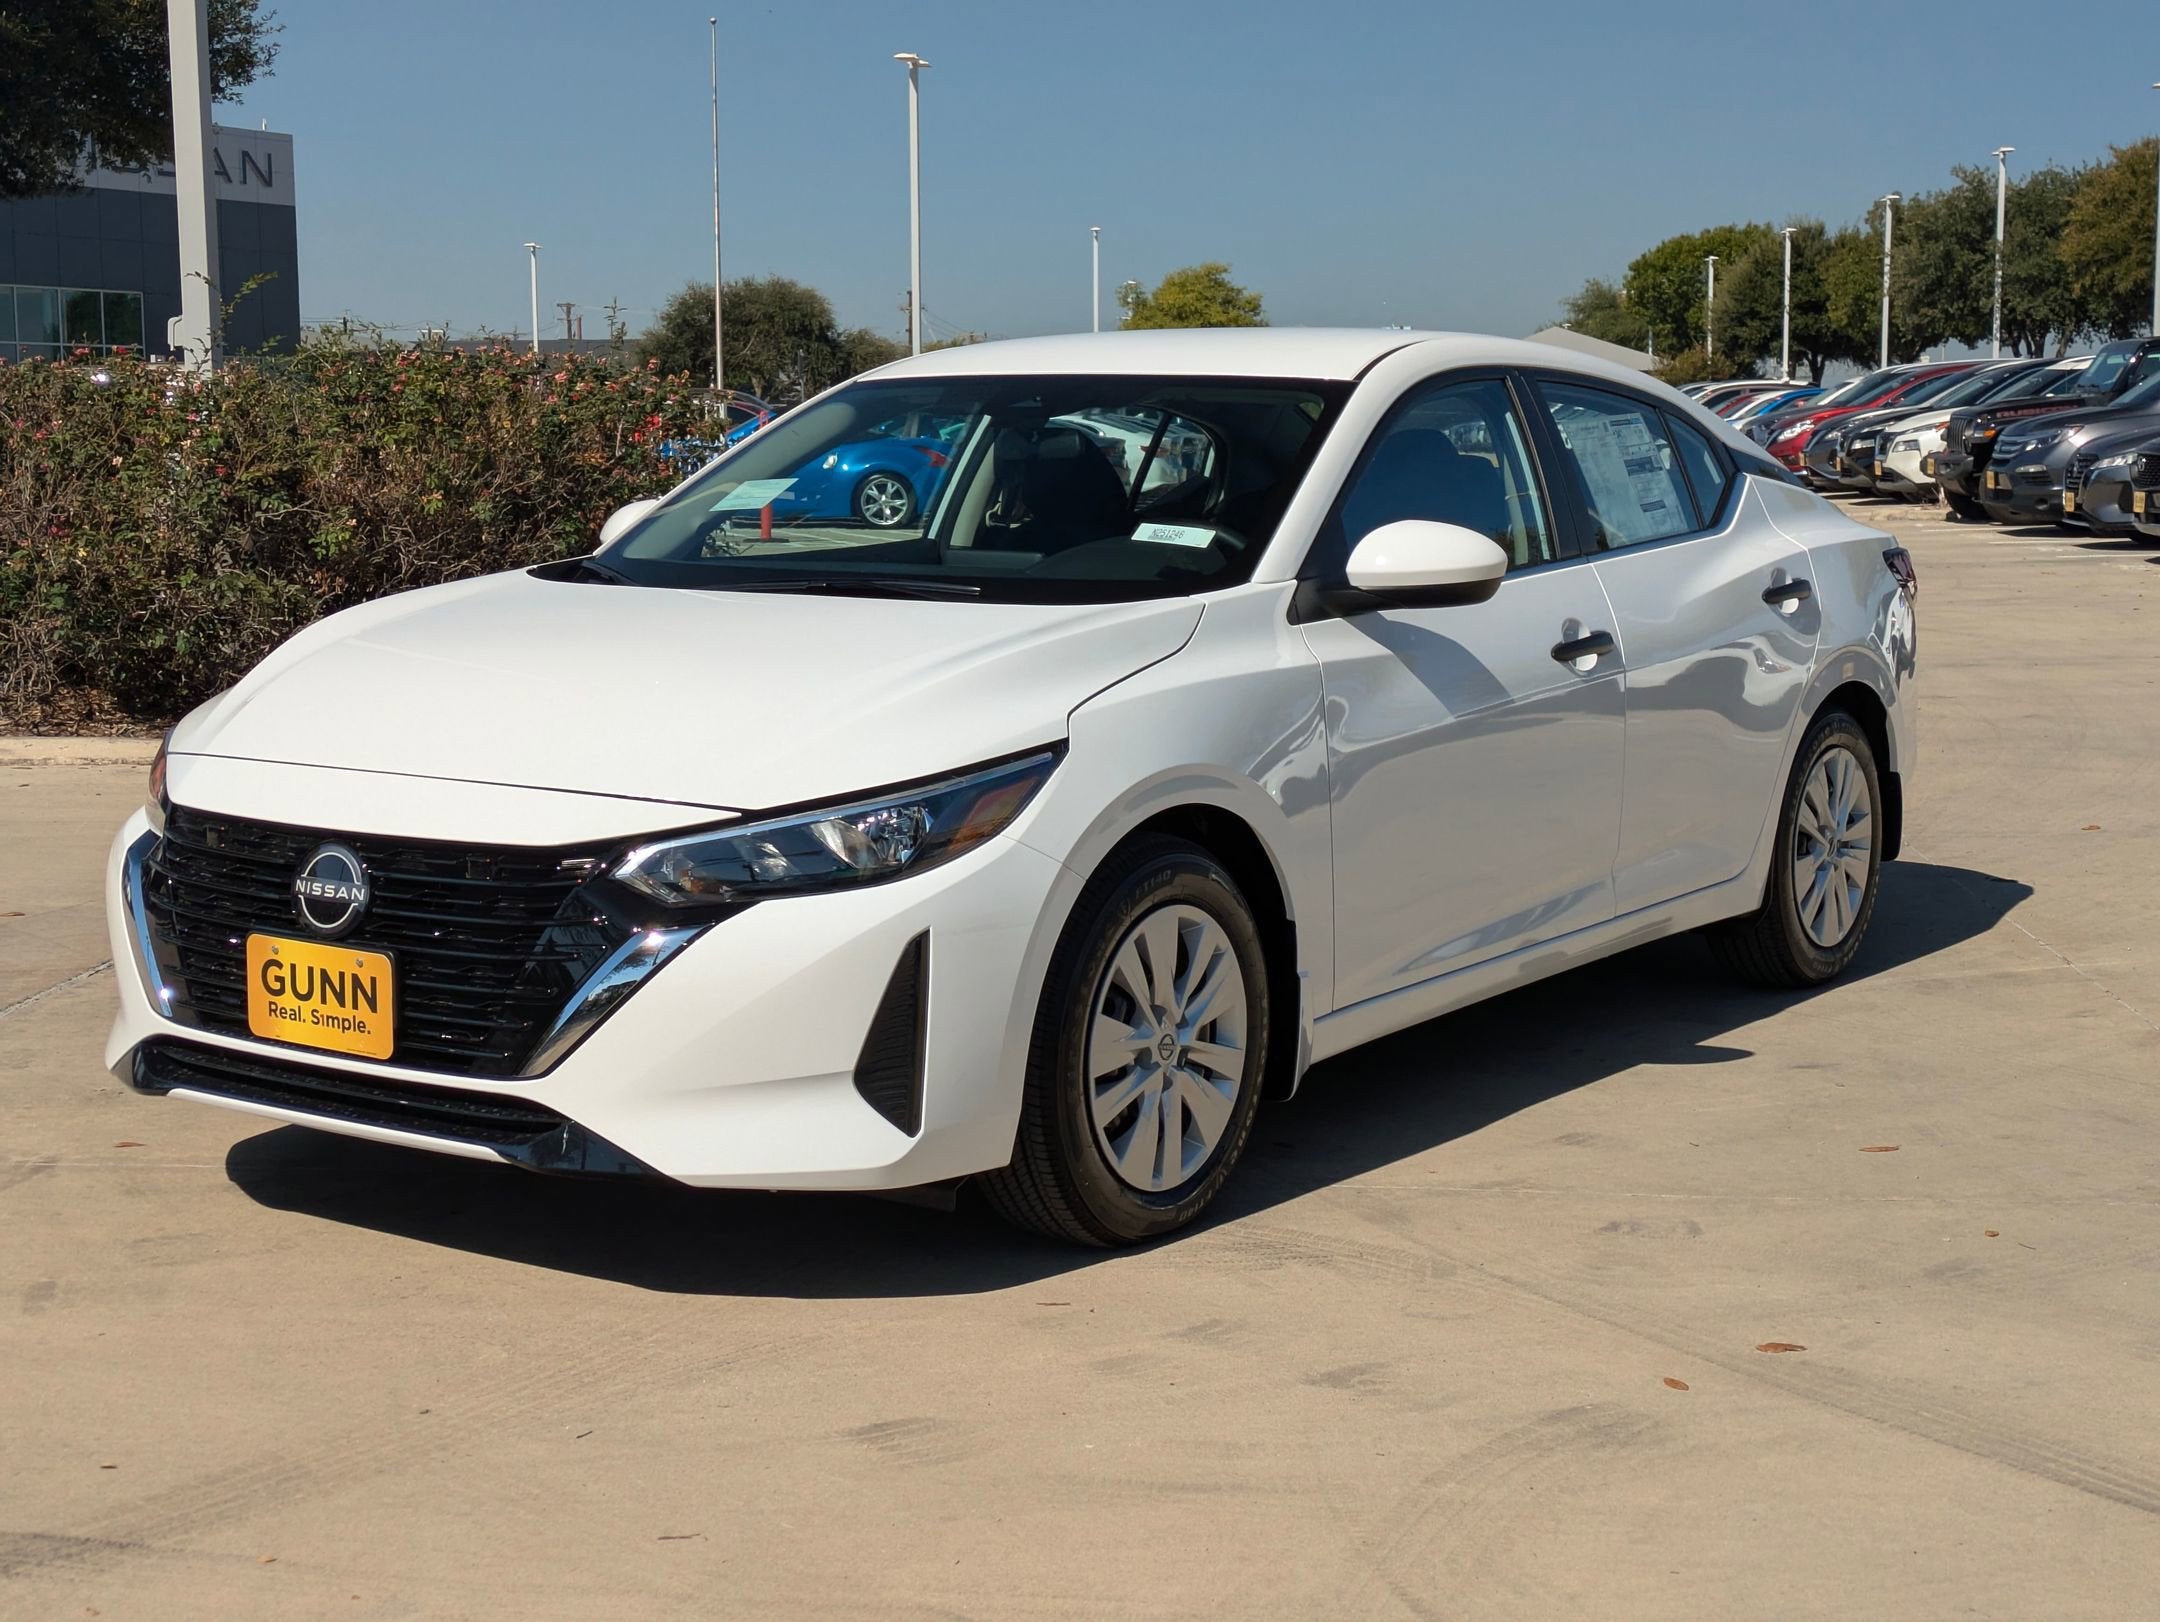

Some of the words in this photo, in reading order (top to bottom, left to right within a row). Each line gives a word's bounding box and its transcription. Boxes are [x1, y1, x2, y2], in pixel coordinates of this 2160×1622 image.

[296, 879, 365, 901] NISSAN
[261, 958, 378, 1014] GUNN
[268, 1000, 306, 1023] Real.
